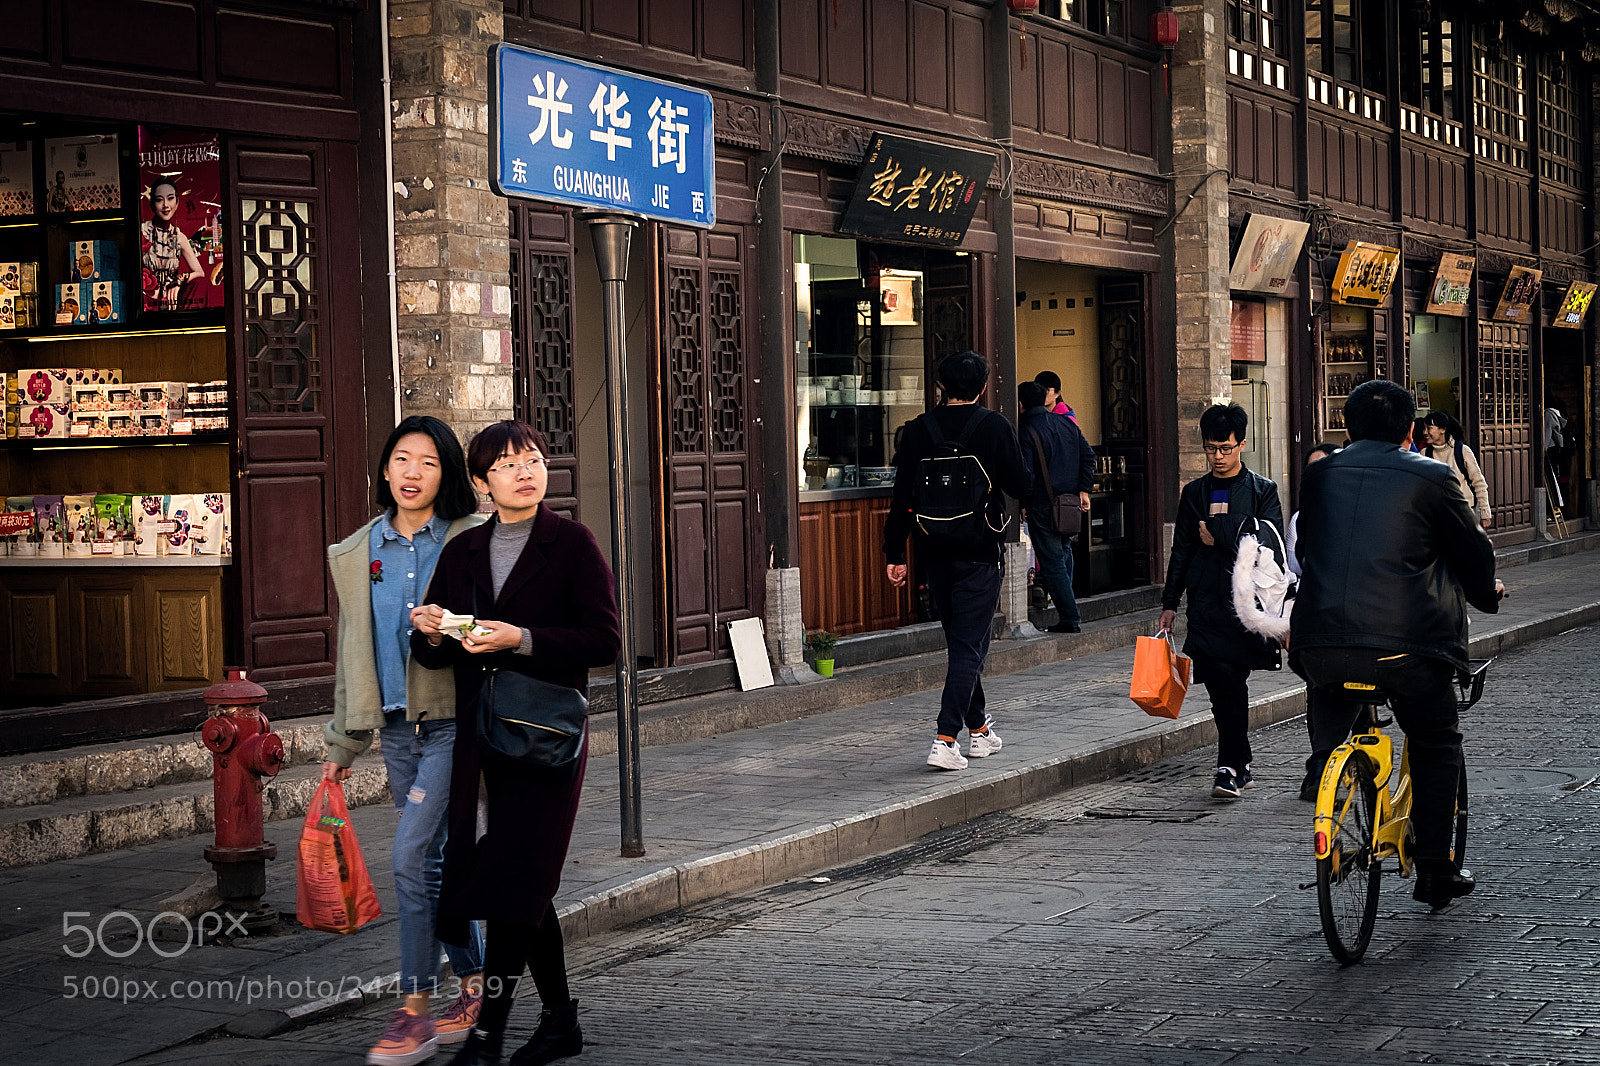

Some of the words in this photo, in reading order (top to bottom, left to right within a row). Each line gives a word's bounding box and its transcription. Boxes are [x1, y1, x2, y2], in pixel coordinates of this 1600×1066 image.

[527, 70, 690, 174] 光华街
[511, 158, 528, 184] 东
[553, 165, 631, 203] GUANGHUA
[651, 184, 670, 209] JIE
[690, 191, 705, 214] 西
[0, 515, 30, 527] 两袋30元
